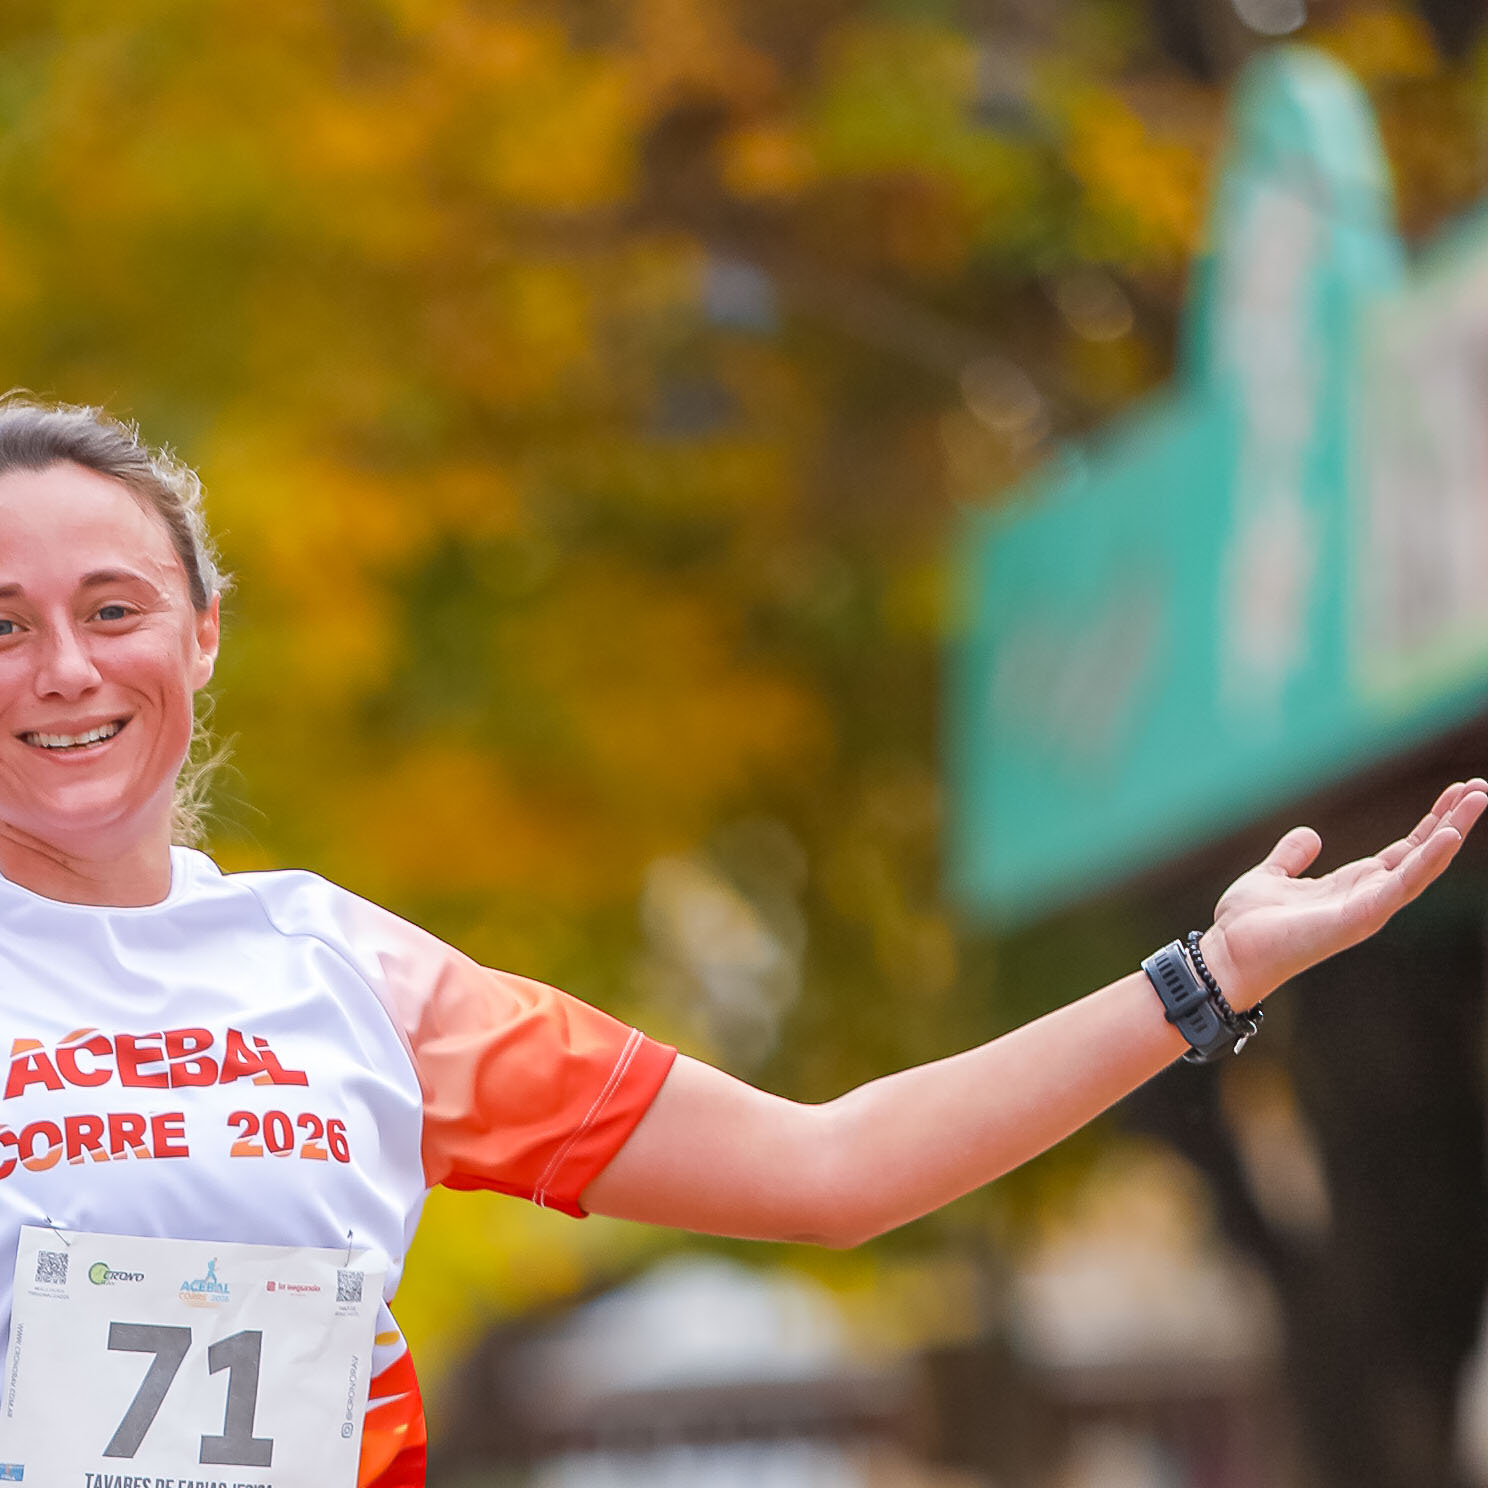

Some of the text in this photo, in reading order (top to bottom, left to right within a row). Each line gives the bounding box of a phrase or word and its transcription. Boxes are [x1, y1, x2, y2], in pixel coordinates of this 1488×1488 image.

[2, 1027, 309, 1101] ACEBAL
[226, 1110, 351, 1164] 2026
[180, 1279, 231, 1294] ACEBAL
[101, 1320, 275, 1468] 71
